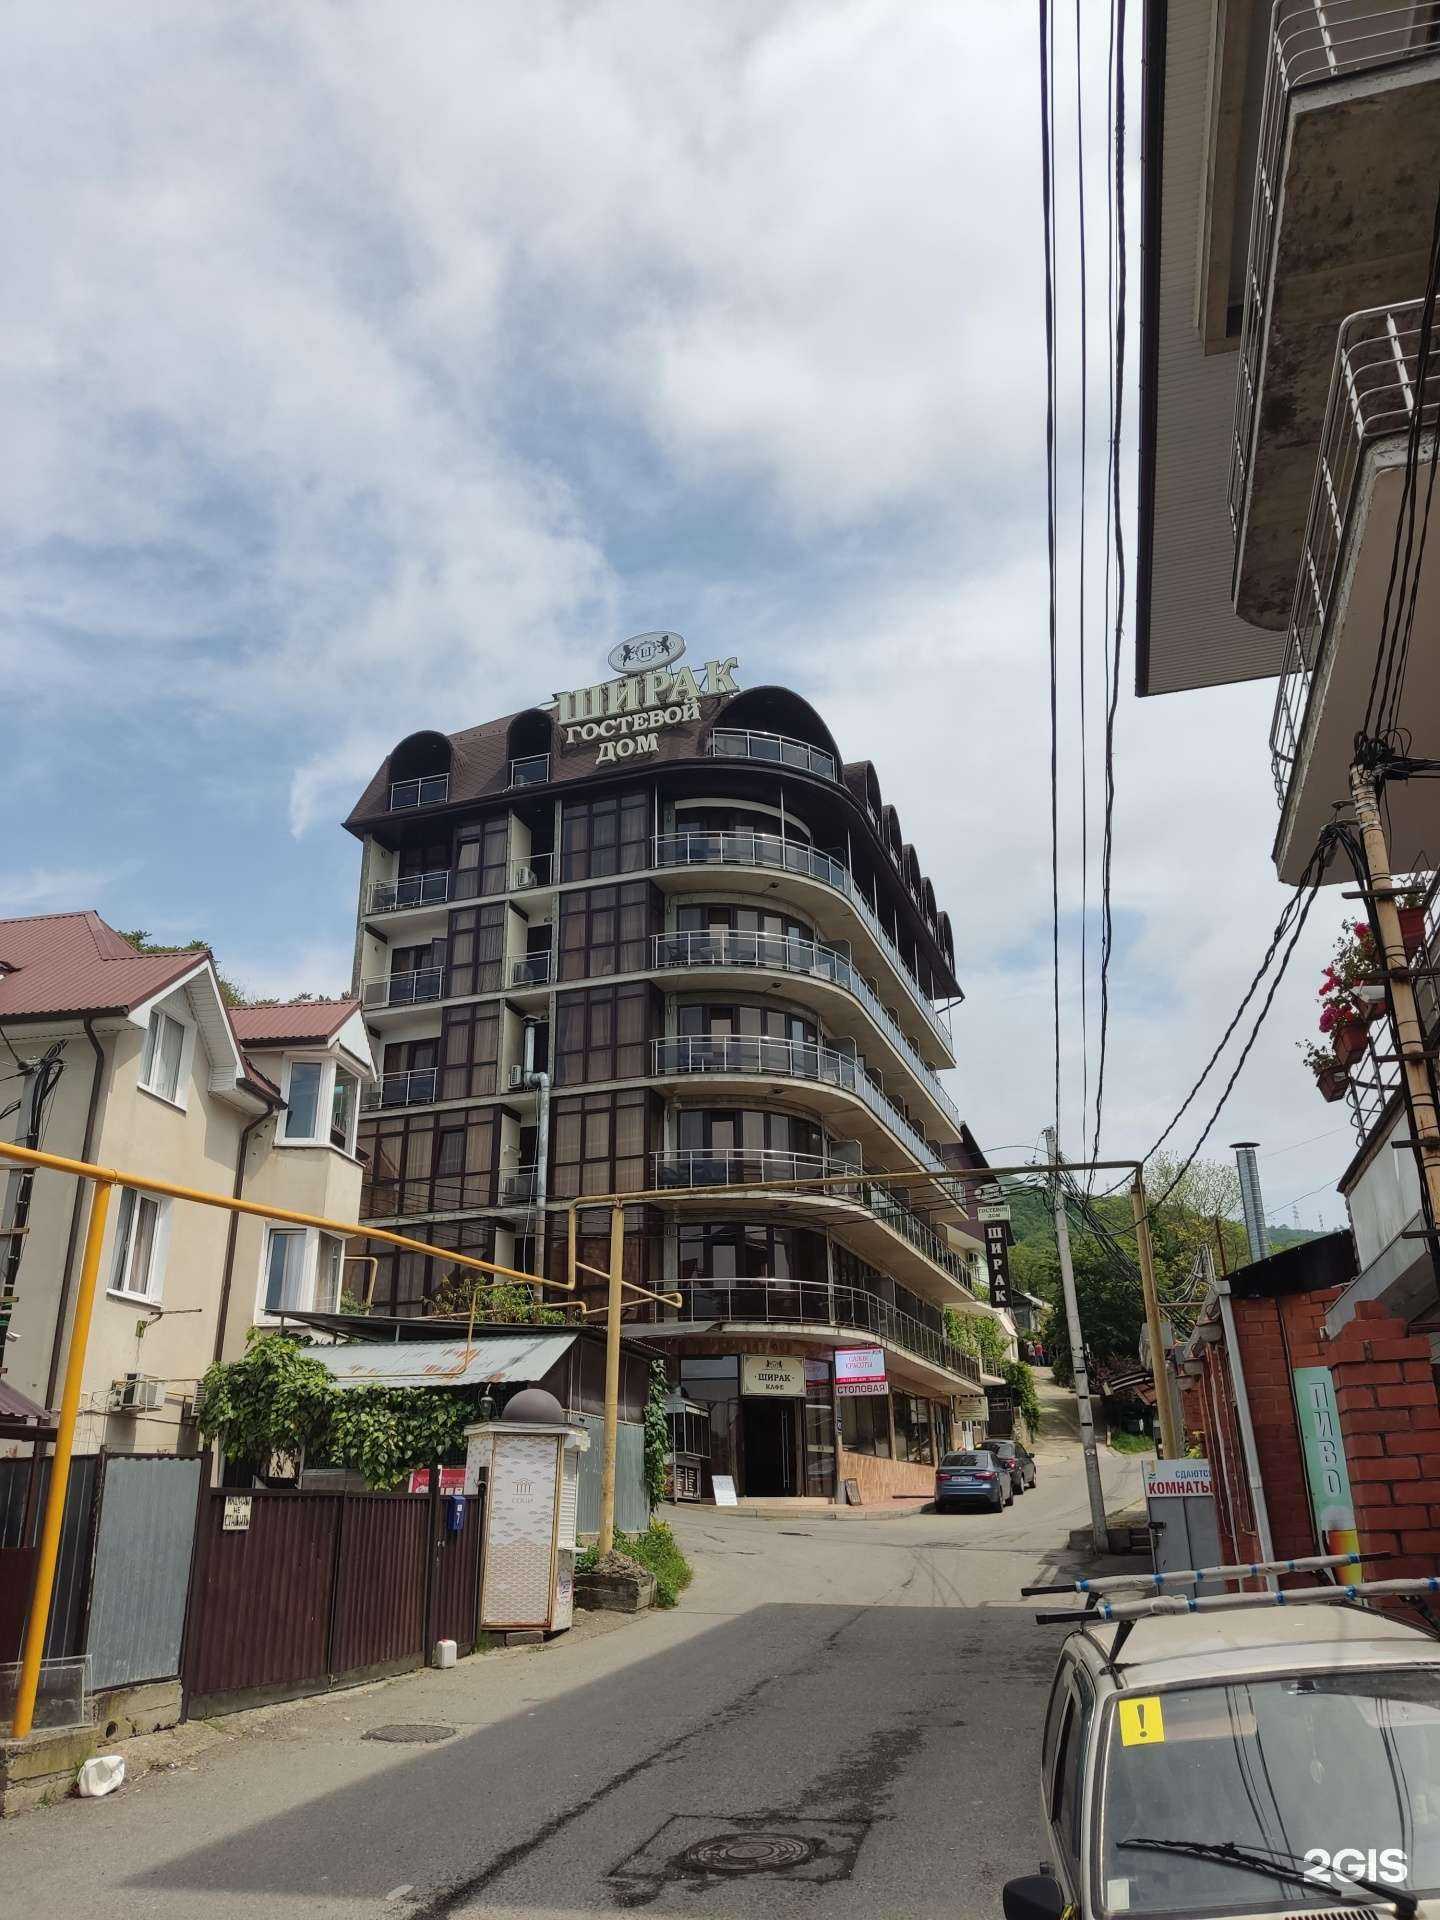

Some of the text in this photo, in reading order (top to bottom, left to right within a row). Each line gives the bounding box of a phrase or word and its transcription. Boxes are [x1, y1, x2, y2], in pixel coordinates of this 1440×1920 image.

[558, 657, 740, 725] ШИРАК
[566, 697, 702, 744] ГОСТЕВОЙ
[596, 732, 660, 764] ДОМ
[988, 1227, 1007, 1302] ШИРАК
[758, 1373, 791, 1382] ШИРАК
[837, 1384, 885, 1394] СТОЛОВАЯ
[1309, 1382, 1341, 1497] ПИВО
[1148, 1480, 1216, 1494] КОМНАТЫ
[233, 1506, 241, 1514] НЕ
